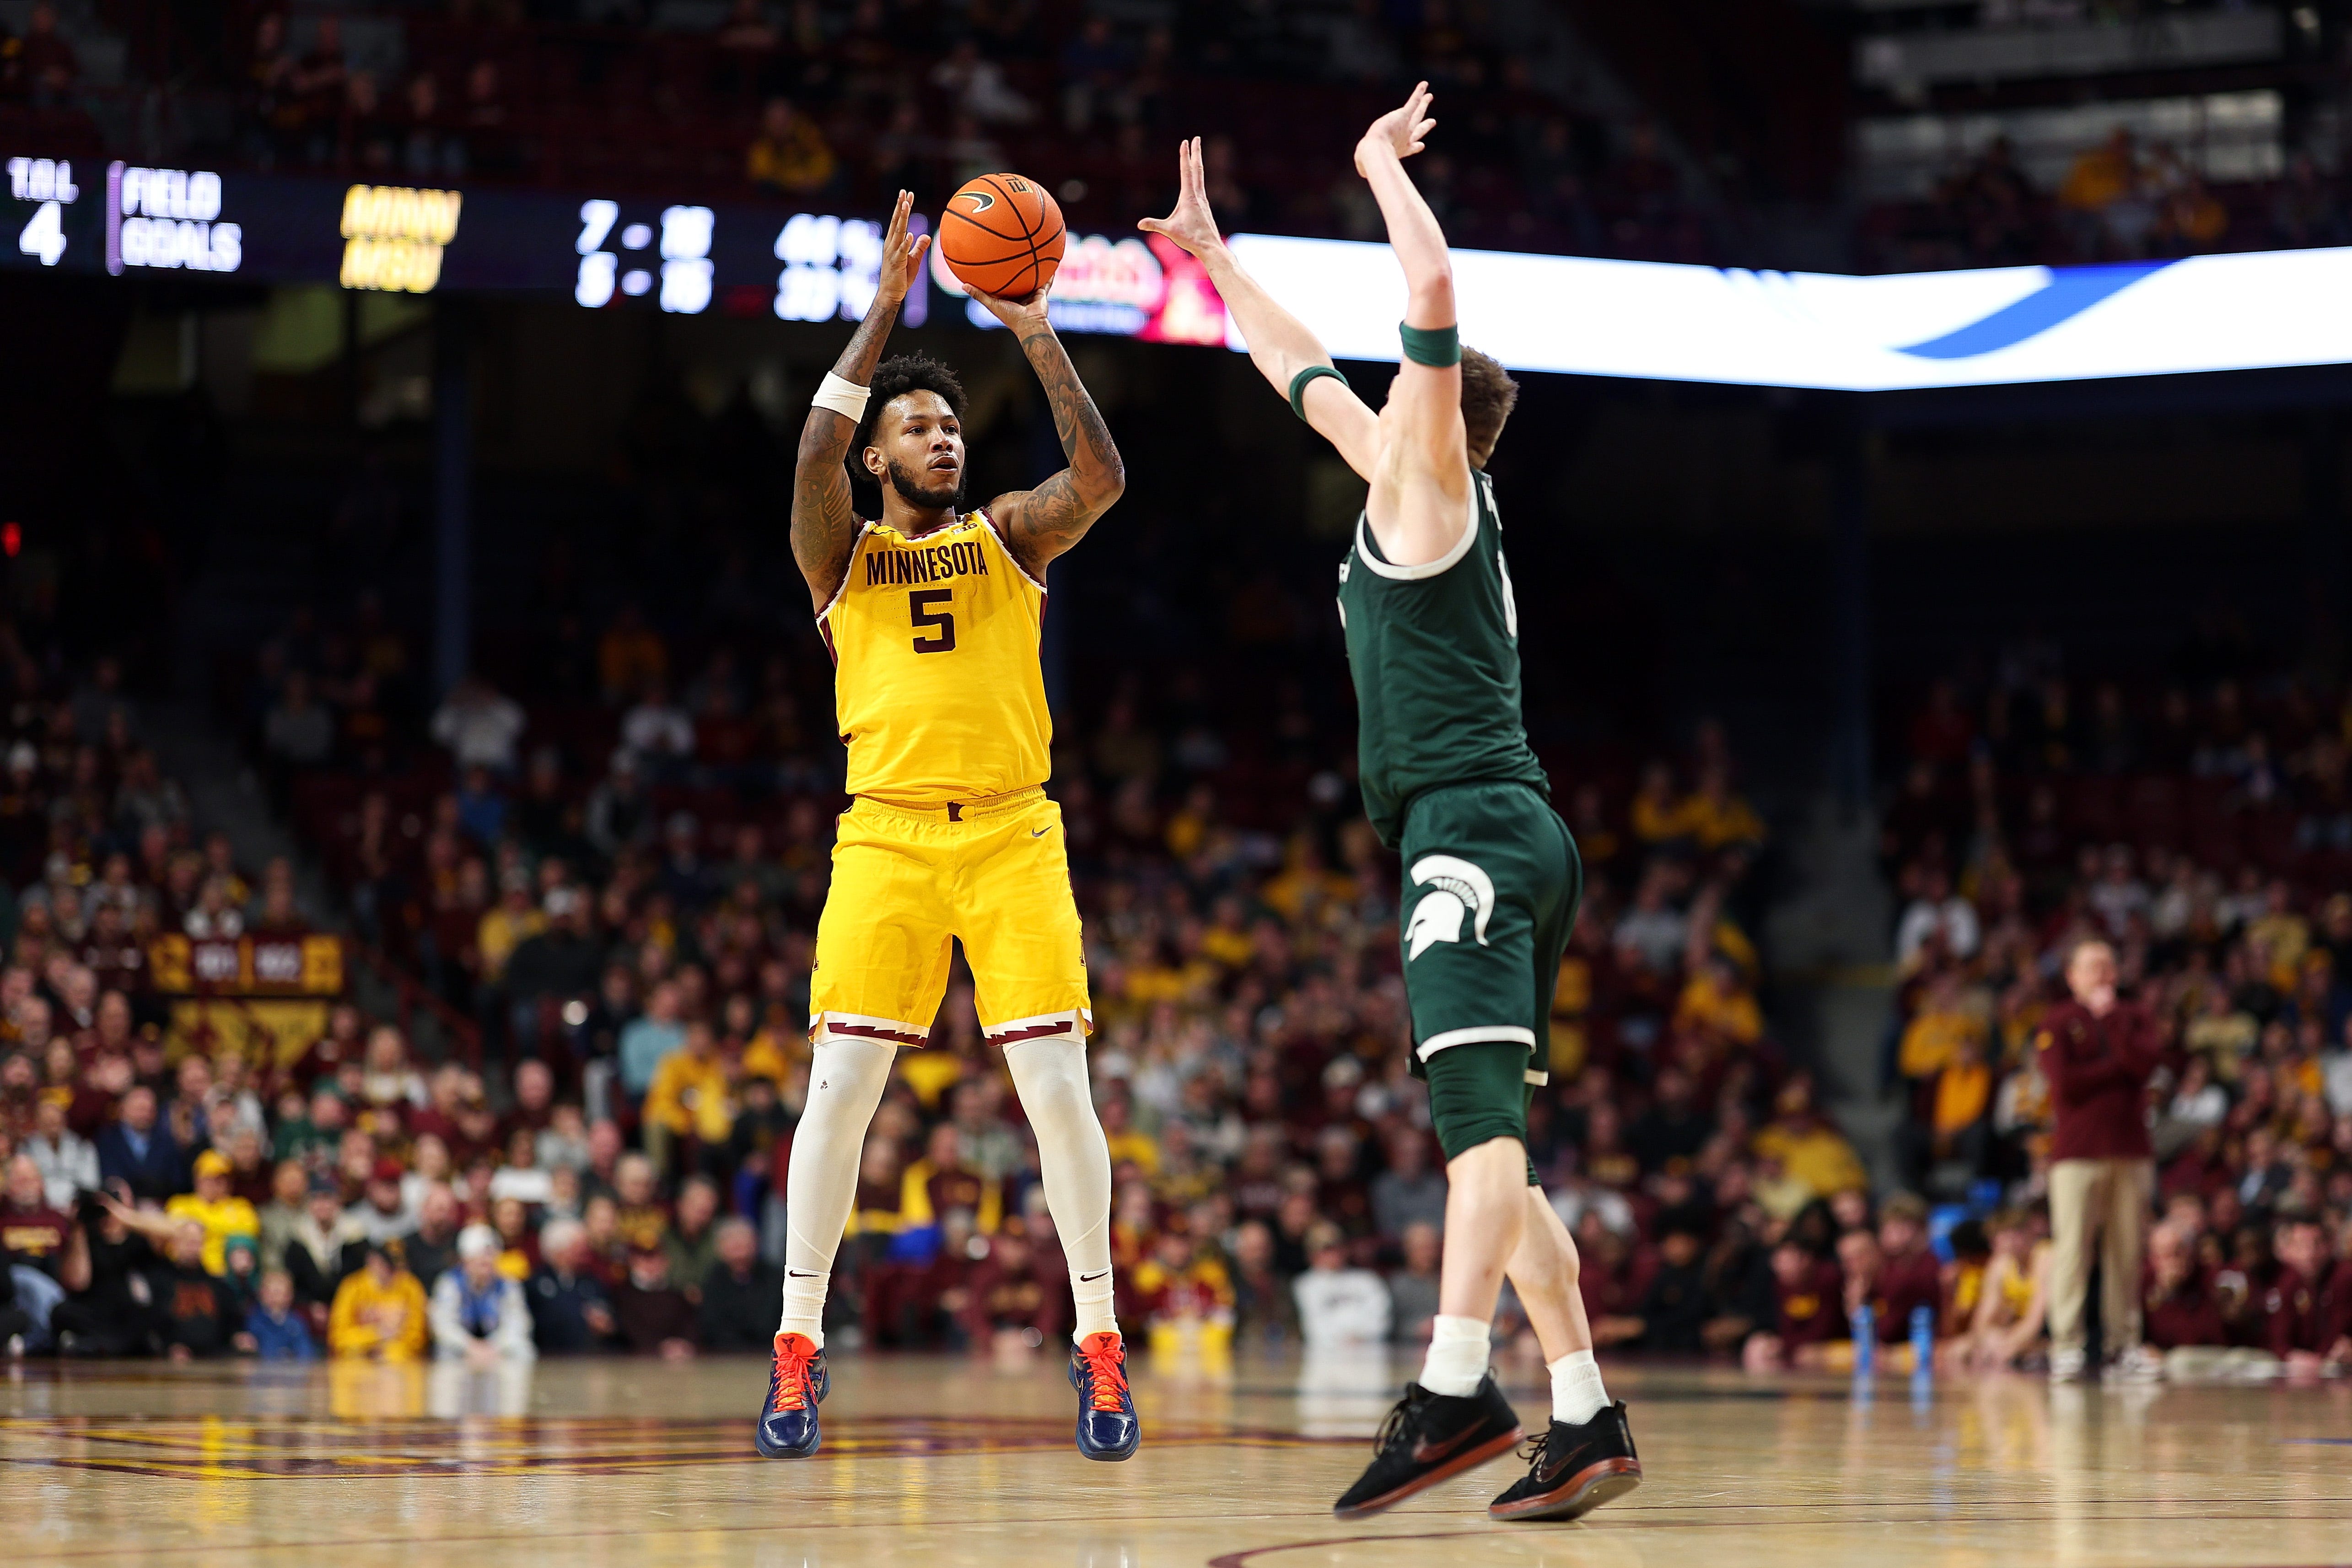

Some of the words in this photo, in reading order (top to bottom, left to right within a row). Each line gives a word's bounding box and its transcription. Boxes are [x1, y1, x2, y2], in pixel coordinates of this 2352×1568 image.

[121, 166, 222, 222] FIELD
[339, 183, 464, 246] MINN
[575, 199, 619, 255] 7
[19, 199, 67, 266] 4
[120, 217, 242, 272] GOALS
[866, 542, 989, 586] MINNESOTA
[909, 588, 956, 654] 5
